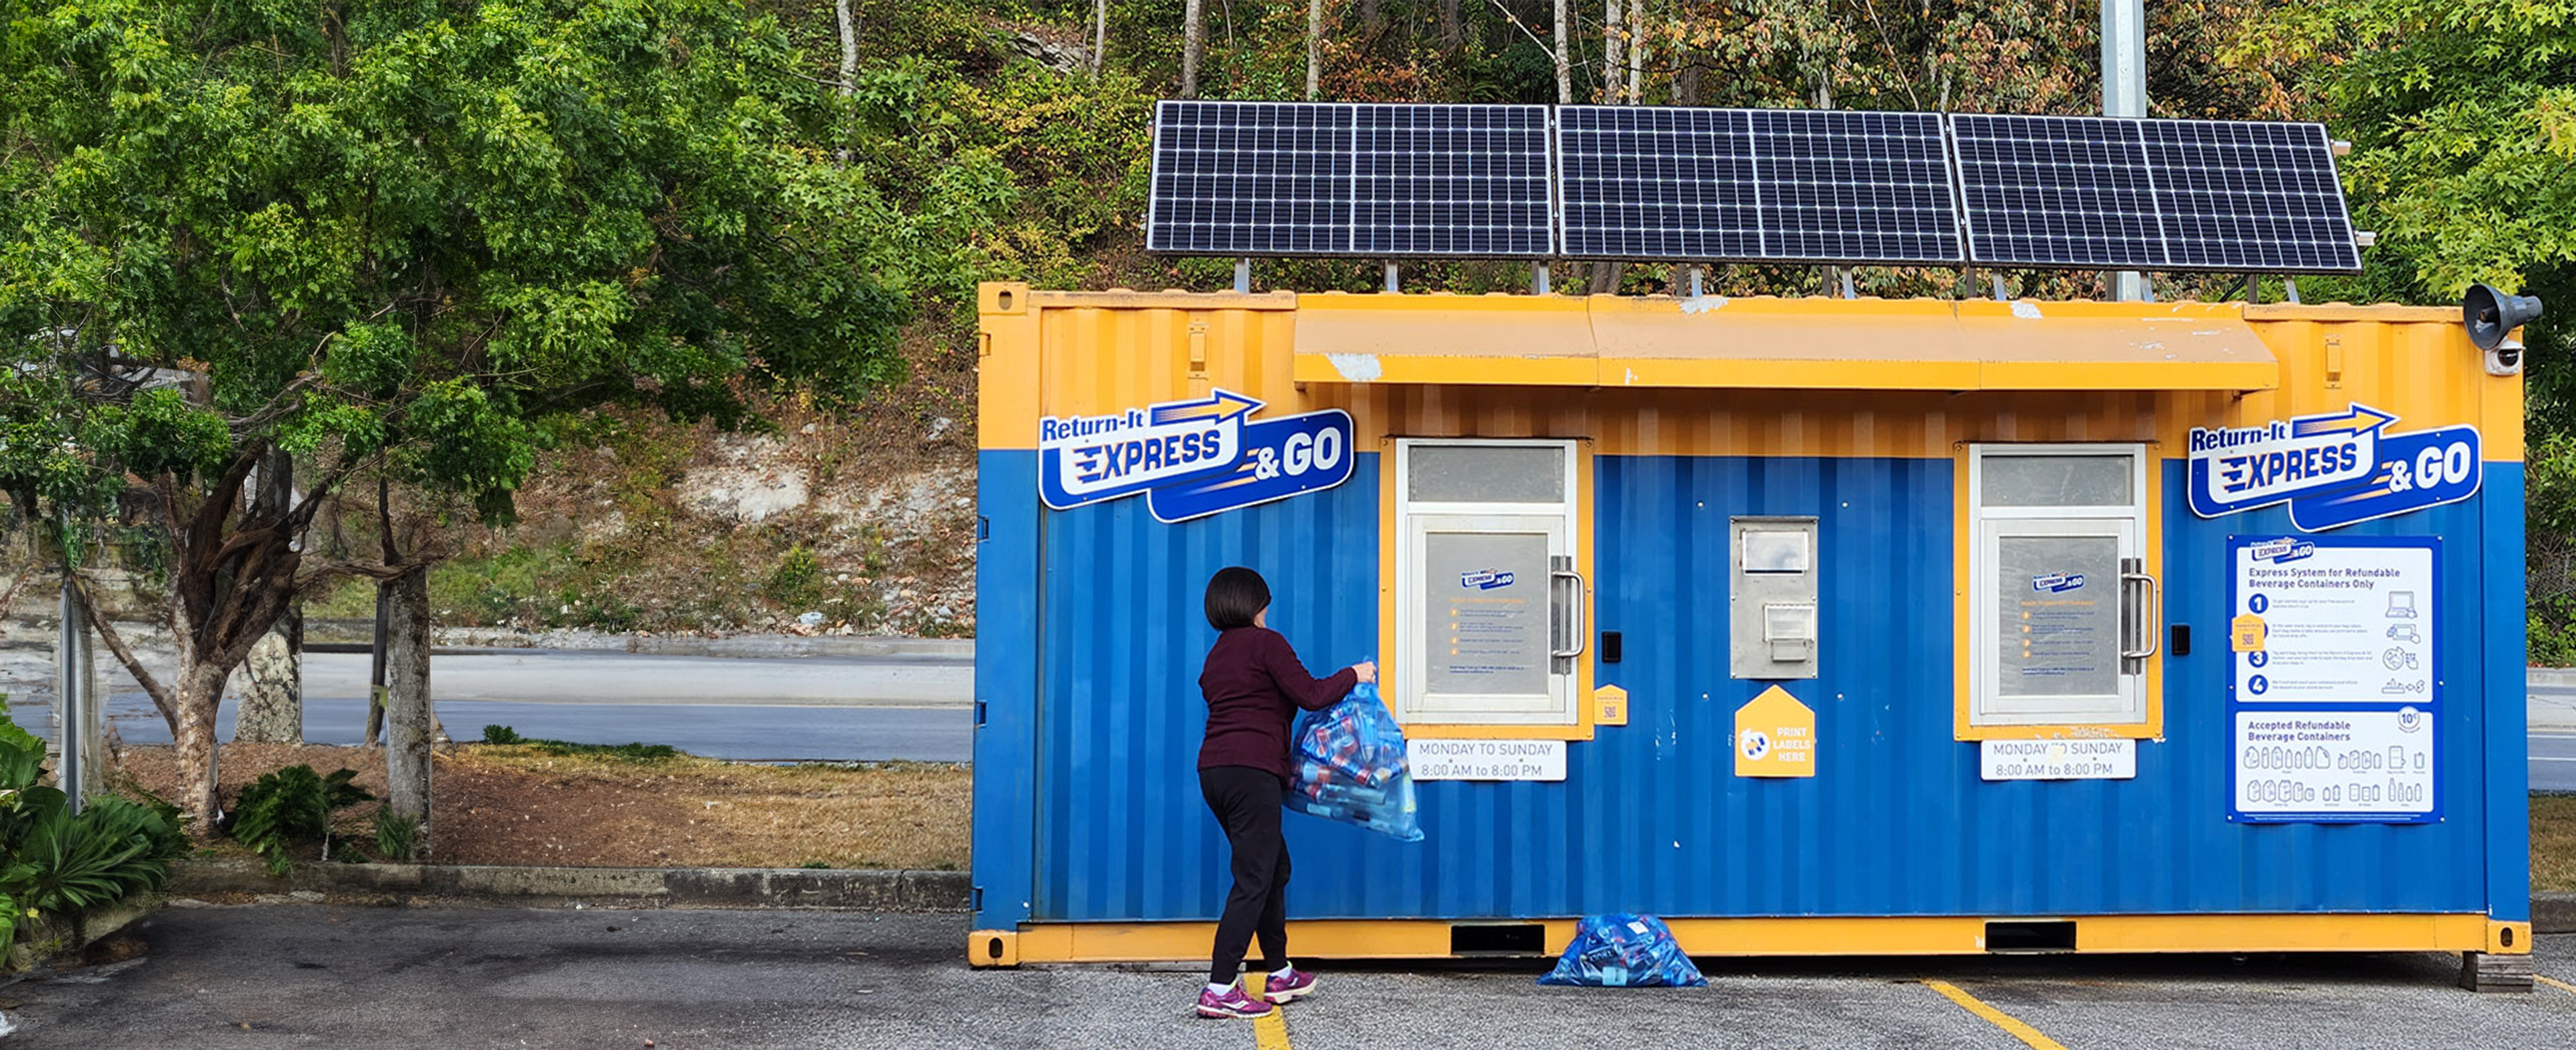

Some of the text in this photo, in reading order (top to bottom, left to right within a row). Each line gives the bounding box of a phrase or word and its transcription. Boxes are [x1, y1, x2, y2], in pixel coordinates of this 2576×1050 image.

[1042, 410, 1144, 441] Return-It
[2191, 423, 2286, 452] Return-It
[1073, 429, 1221, 484] EXPRESS
[2220, 443, 2357, 493] EXPRESS
[2249, 568, 2401, 578] Express System for Refundable
[2249, 579, 2375, 590] Beverage Containers Only
[2254, 596, 2263, 611] 1
[2253, 651, 2264, 666] 3
[2252, 678, 2264, 692] 4
[1777, 727, 1807, 736] PRINT
[2247, 721, 2351, 731] Accepted Refundable
[1772, 739, 1811, 749] LABELS
[2248, 732, 2351, 743] Beverage Containers
[1419, 743, 1553, 755] MONDAY TO SUNDAY
[1993, 743, 2048, 755] MONDAY
[2071, 742, 2123, 754] SUNDAY
[1778, 752, 1806, 762] HERE
[1421, 764, 1542, 777] 8:00 AM to 8:00 PM
[1996, 763, 2113, 776] 8:00 AM to 8:00 PM
